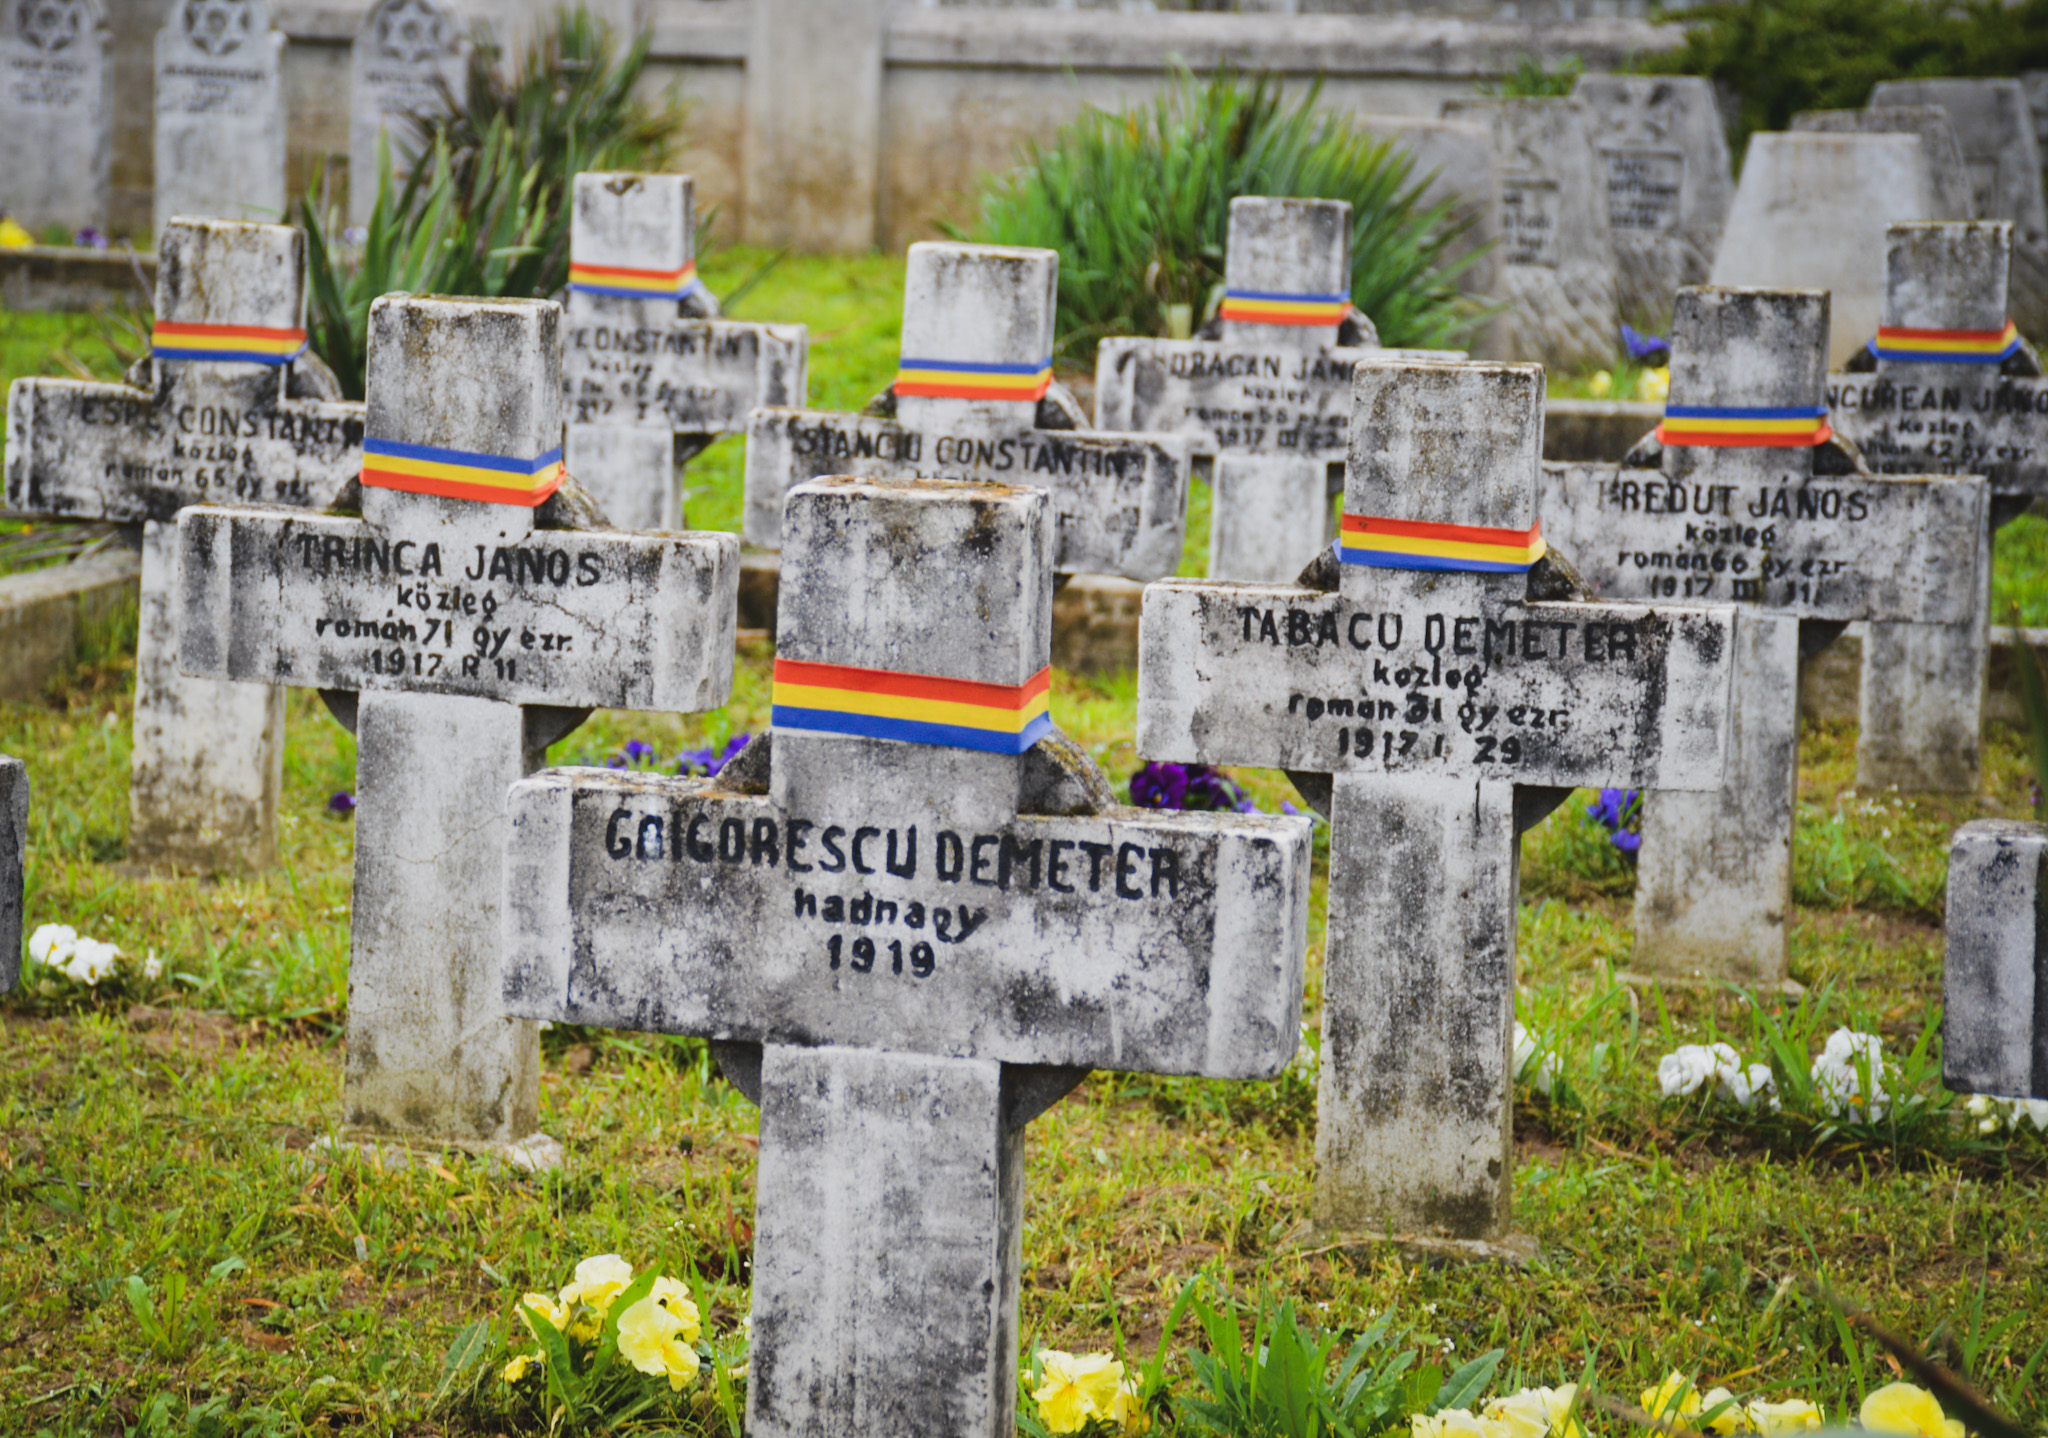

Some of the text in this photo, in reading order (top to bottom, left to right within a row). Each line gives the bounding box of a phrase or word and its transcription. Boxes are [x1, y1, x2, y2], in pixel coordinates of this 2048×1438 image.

[1620, 479, 1740, 517] REDUT
[299, 533, 443, 577] TRINCA
[1237, 606, 1638, 662] TABACU DEMETER
[372, 648, 443, 678] 1917
[1339, 726, 1419, 761] 1917
[1473, 735, 1522, 764] 29
[935, 829, 1182, 900] DEMETER
[794, 887, 989, 945] hadnagy
[826, 934, 936, 979] 1919
